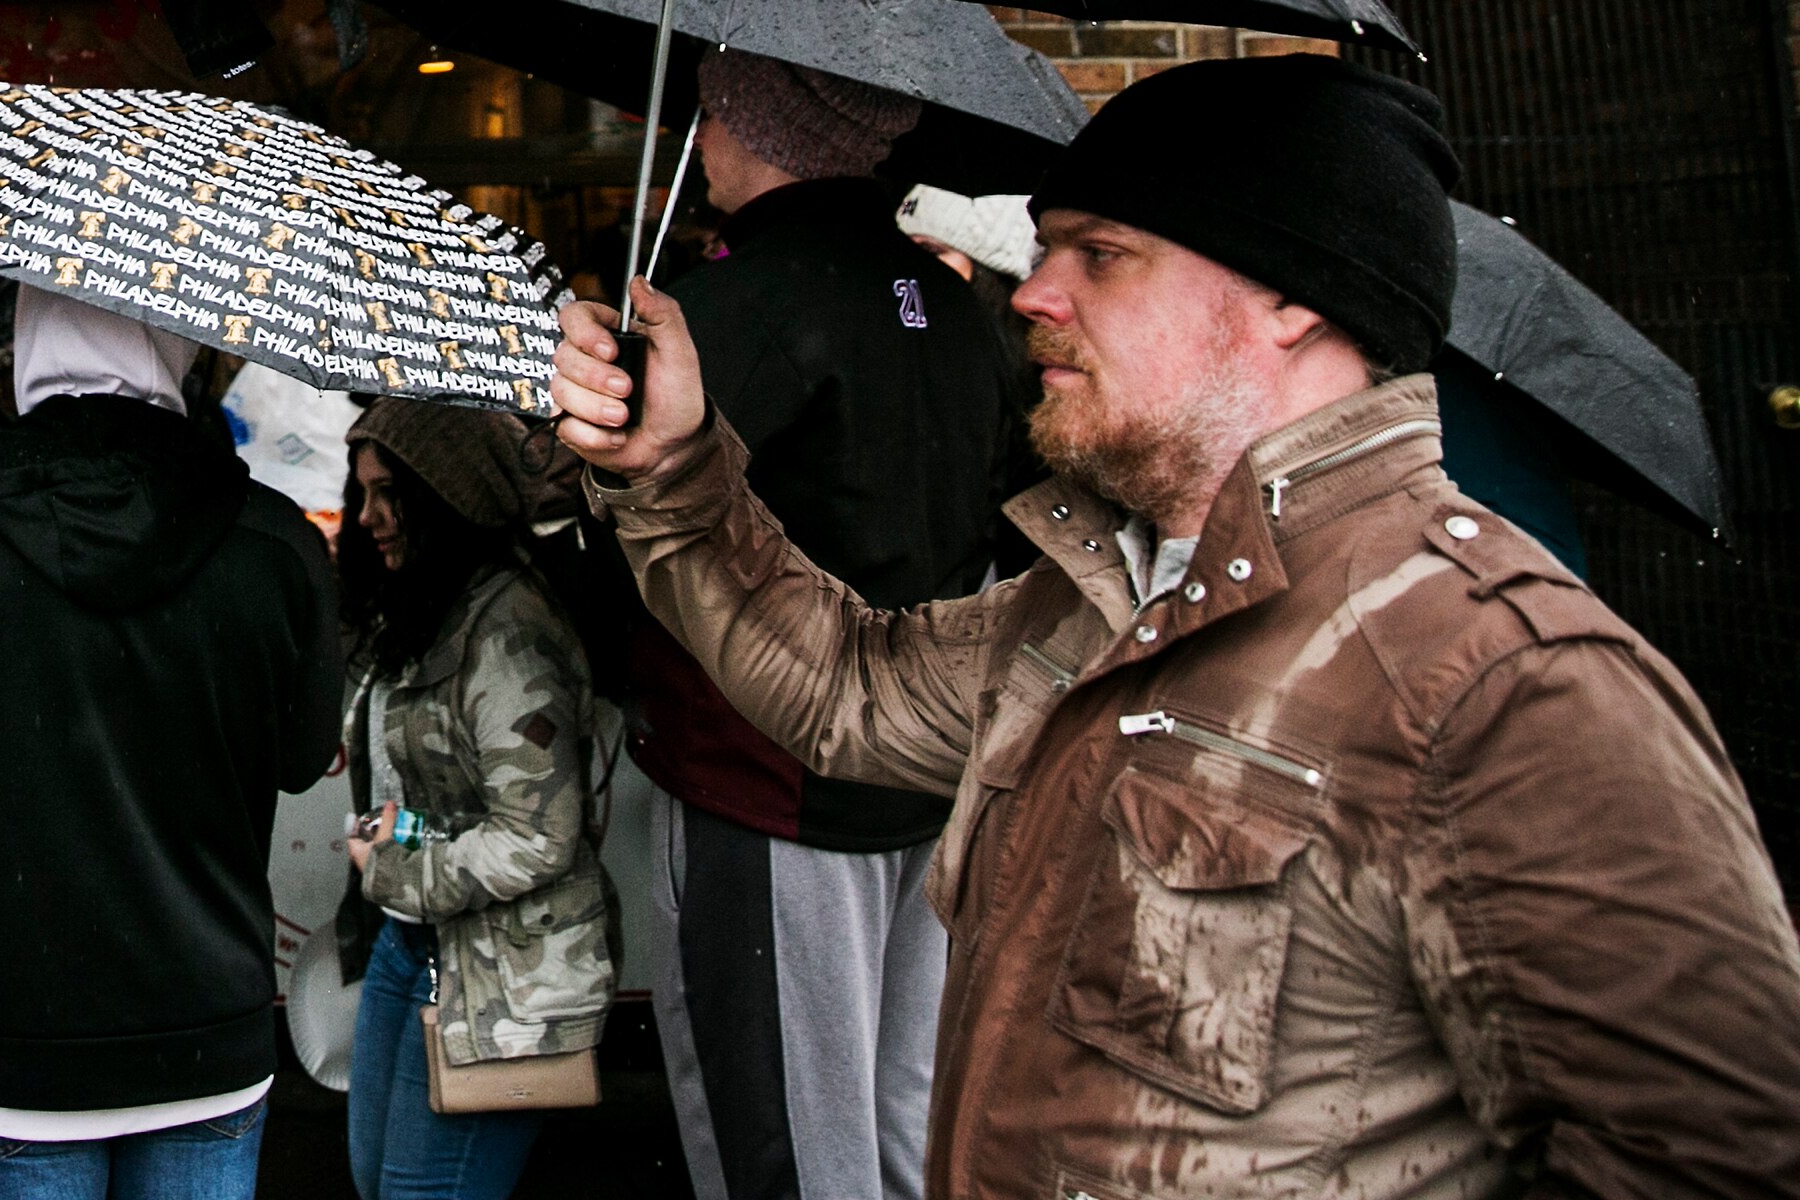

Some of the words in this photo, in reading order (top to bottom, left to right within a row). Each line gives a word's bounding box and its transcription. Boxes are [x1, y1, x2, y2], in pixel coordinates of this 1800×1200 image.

[11, 218, 148, 278] PHILADELPHIA
[177, 273, 316, 336] PHILADELPHIA
[330, 325, 441, 364] PHILADELPHIA
[106, 221, 242, 283] PHILADELPHIA
[390, 309, 502, 347] PHILADELPHIA
[128, 178, 262, 239] PHILADELPHIA
[376, 258, 487, 294] PHILADELPHIA
[83, 268, 220, 331] PHILADELPHIA
[402, 365, 515, 402] PHILADELPHIA
[893, 278, 928, 328] 21
